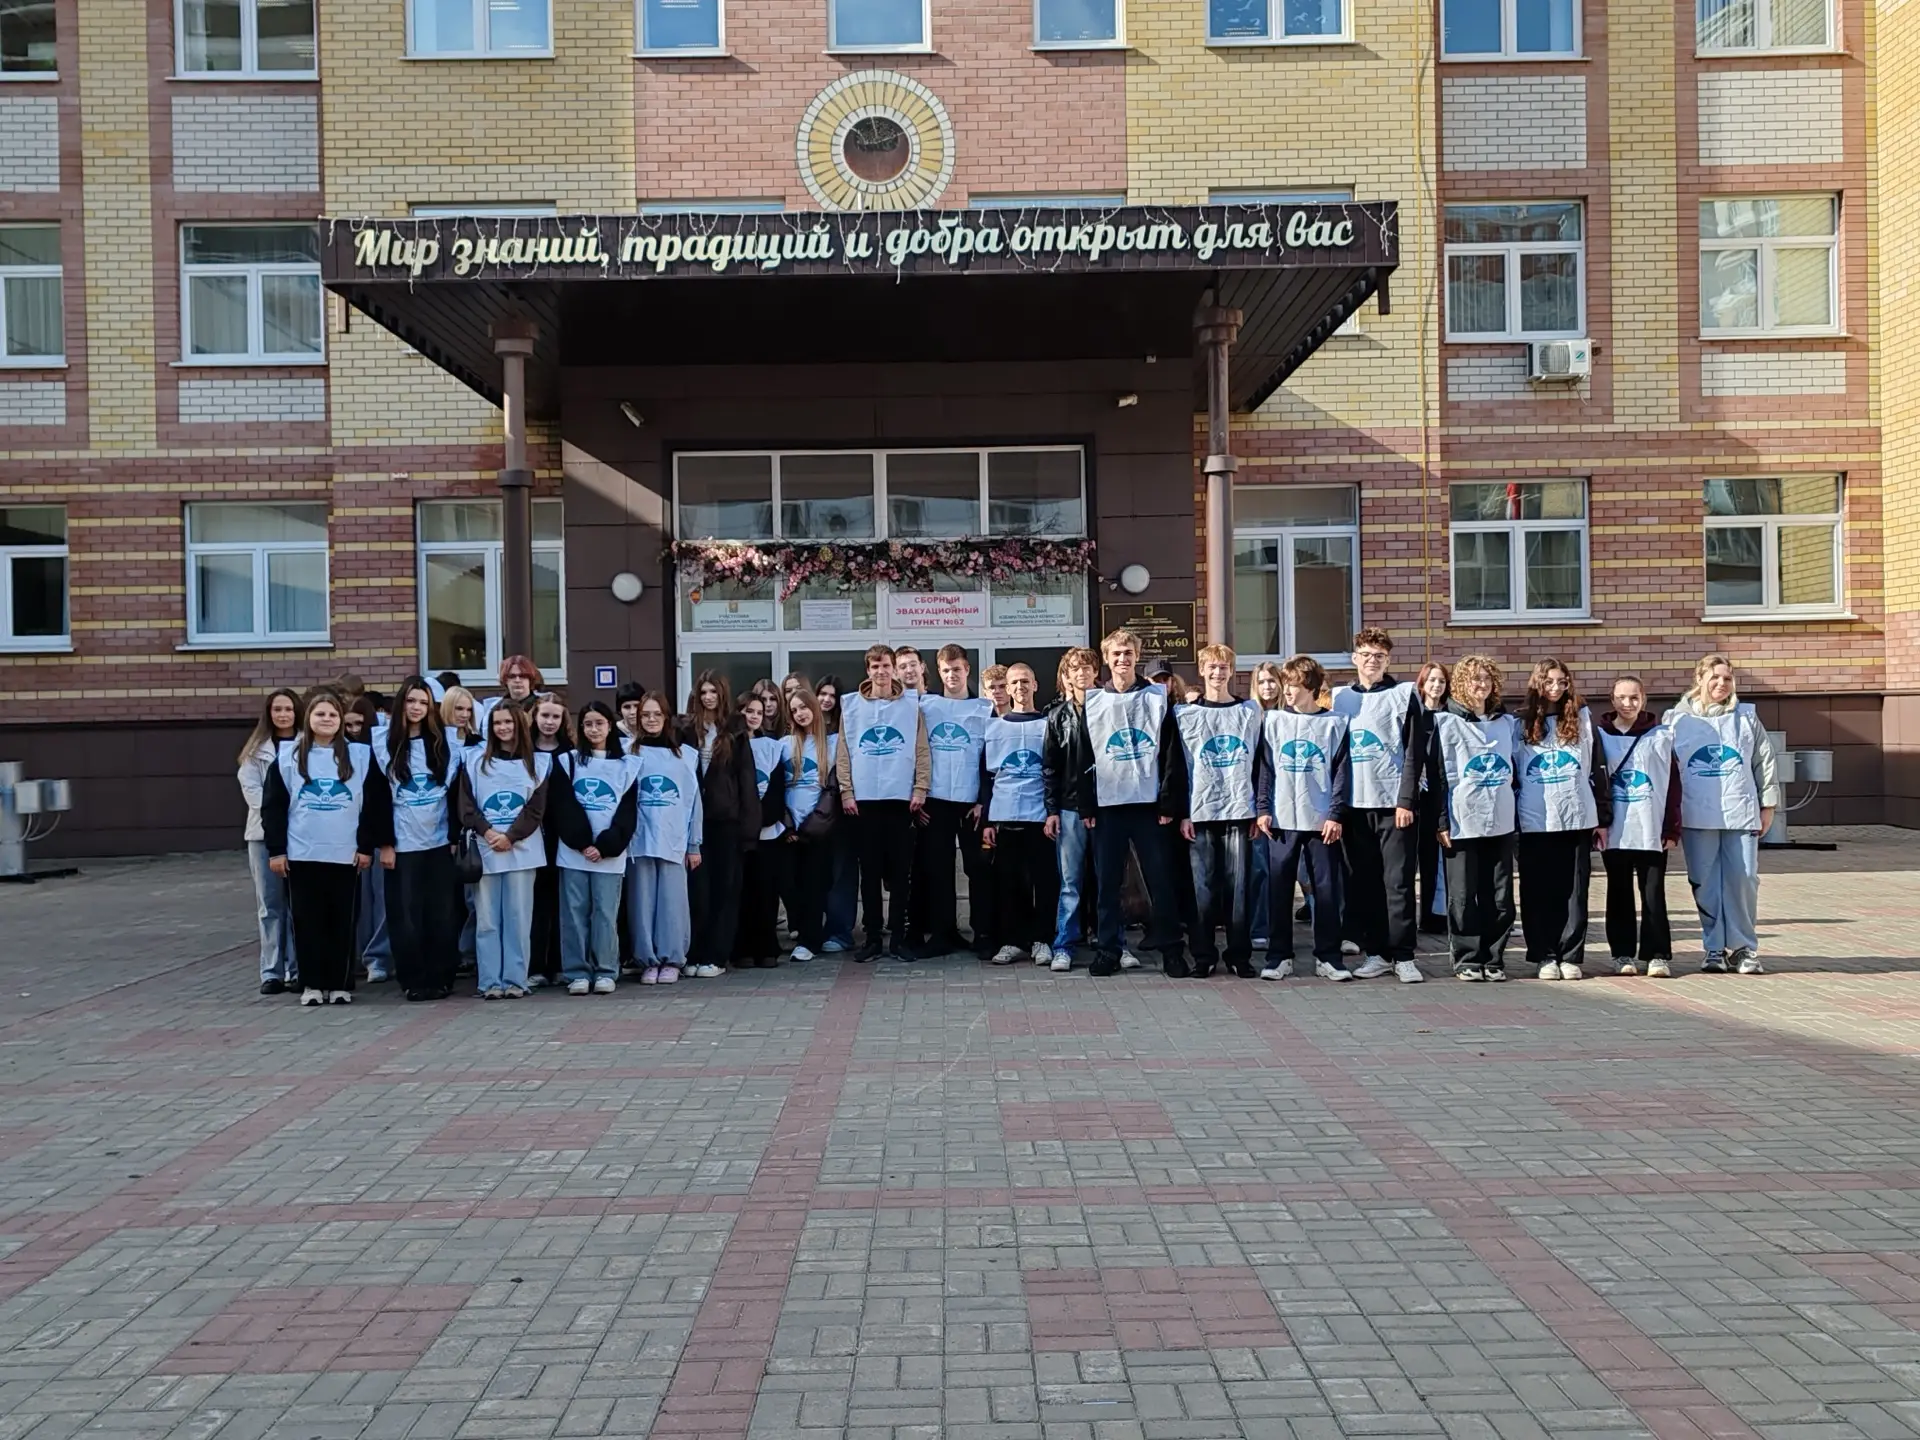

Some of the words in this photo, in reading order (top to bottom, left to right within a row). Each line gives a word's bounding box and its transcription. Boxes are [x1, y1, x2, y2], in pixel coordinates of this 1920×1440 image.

[354, 229, 439, 276] Мир
[451, 228, 610, 275] знаний,
[622, 223, 834, 273] традиций
[845, 231, 873, 258] и
[885, 216, 1004, 265] добра
[1010, 222, 1187, 263] открыт
[1193, 222, 1273, 261] для
[1285, 211, 1355, 248] вас
[914, 595, 960, 604] СБОРНЫЙ
[895, 605, 979, 615] ЭВАКУАЦИОННЫЙ
[943, 618, 965, 626] №62
[1164, 638, 1189, 648] №60
